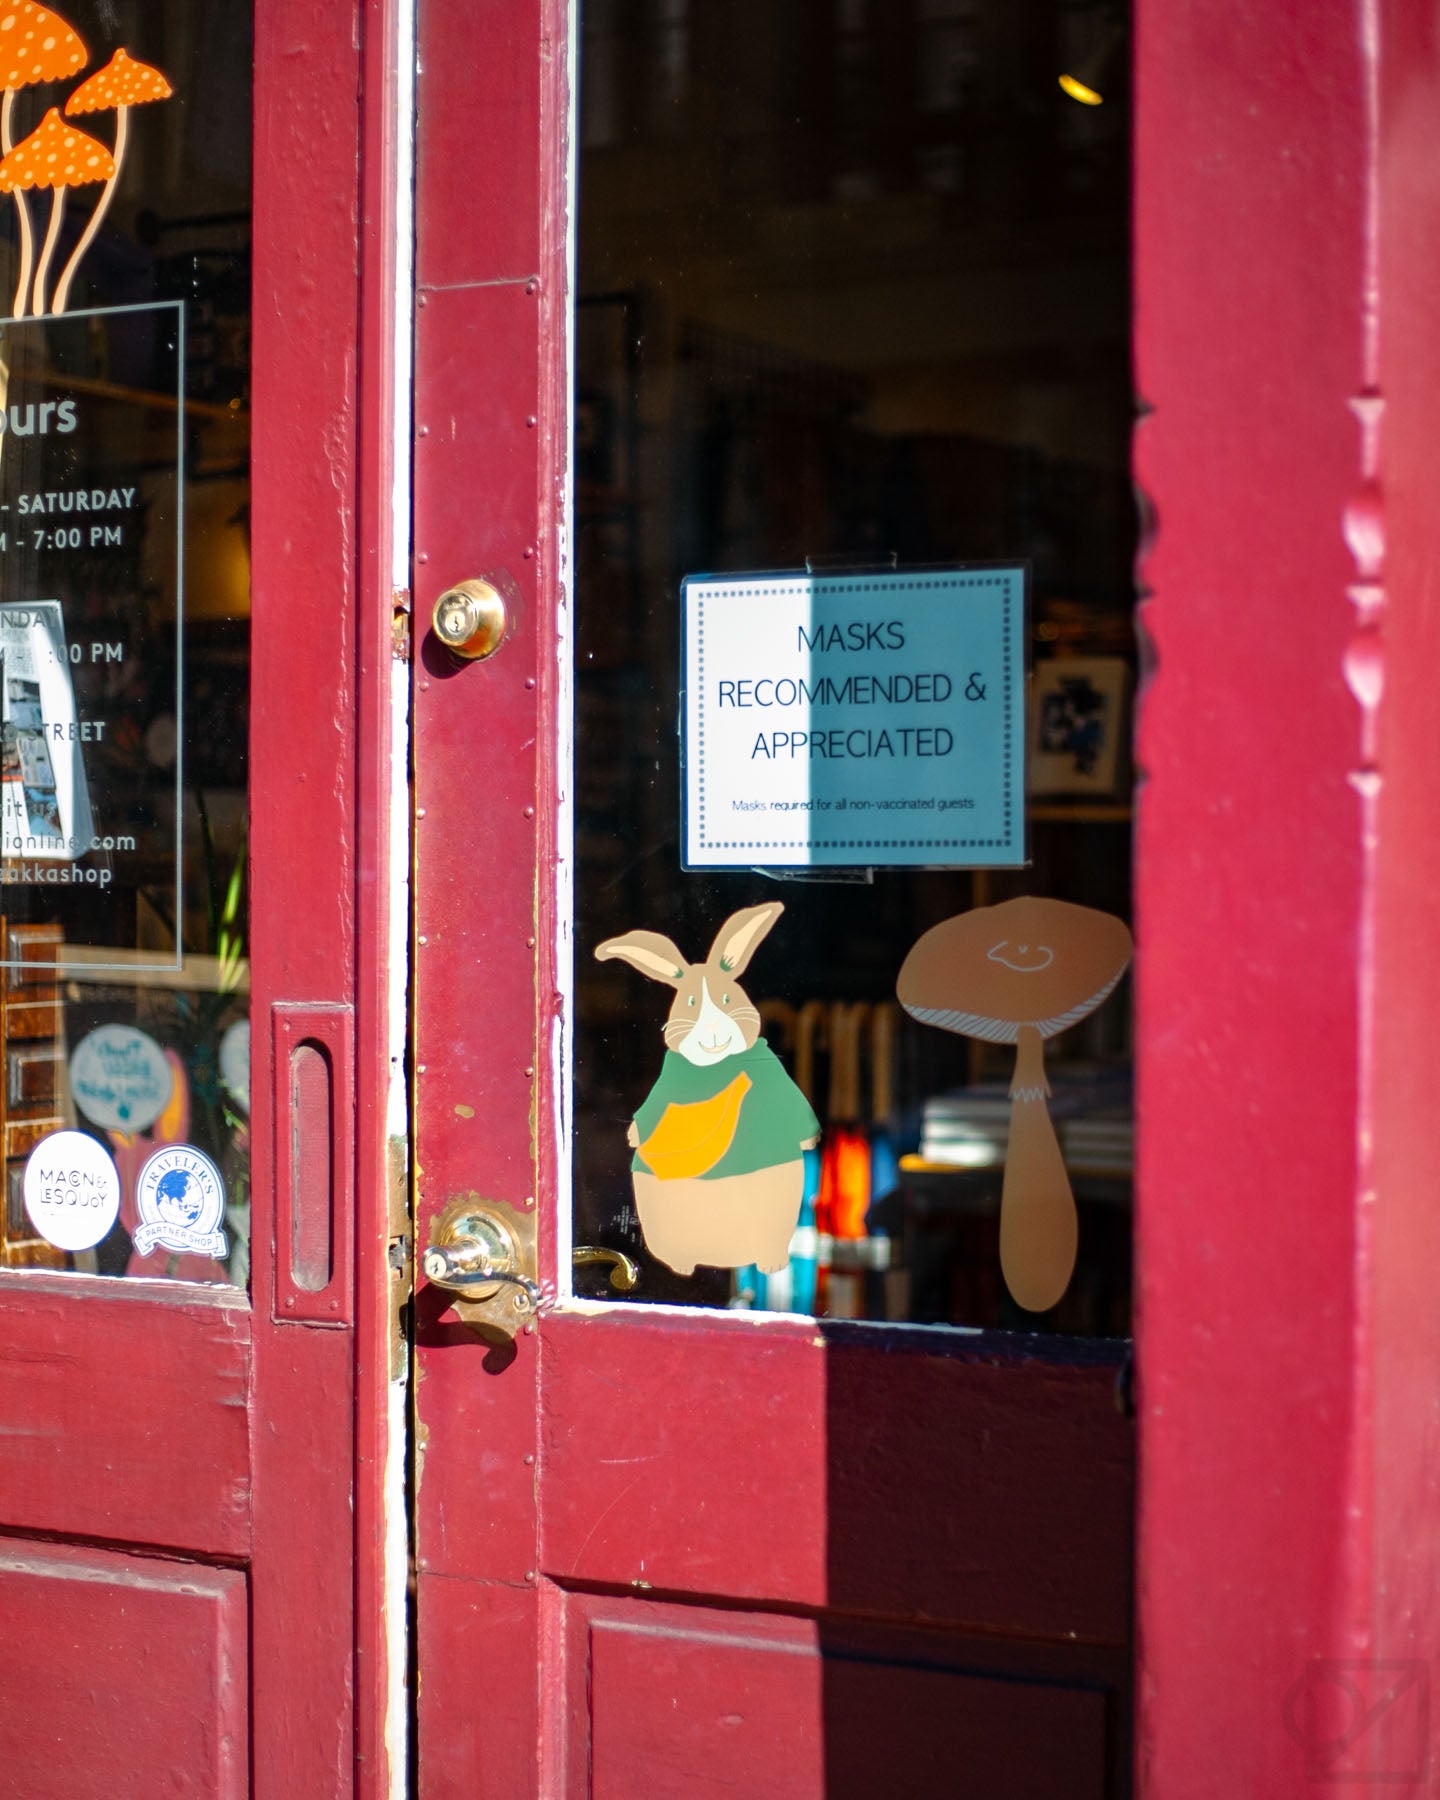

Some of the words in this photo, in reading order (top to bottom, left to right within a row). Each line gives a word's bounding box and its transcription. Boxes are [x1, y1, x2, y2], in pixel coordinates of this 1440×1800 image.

[0, 400, 77, 436] urs
[18, 487, 136, 515] SATURDAY
[34, 527, 81, 551] 7:00
[90, 526, 122, 547] PM
[798, 621, 905, 653] MASKS
[91, 642, 122, 663] PM
[718, 674, 952, 708] RECOMMENDED
[964, 672, 987, 702] &
[751, 728, 954, 760] APPRECIATED
[732, 800, 767, 811] Masks
[769, 799, 814, 813] required
[816, 799, 832, 810] for
[835, 799, 847, 810] all
[850, 798, 935, 811] non-vaccinated
[938, 798, 975, 812] guests
[145, 1226, 188, 1239] PARTNER
[189, 1234, 213, 1247] SHOP
